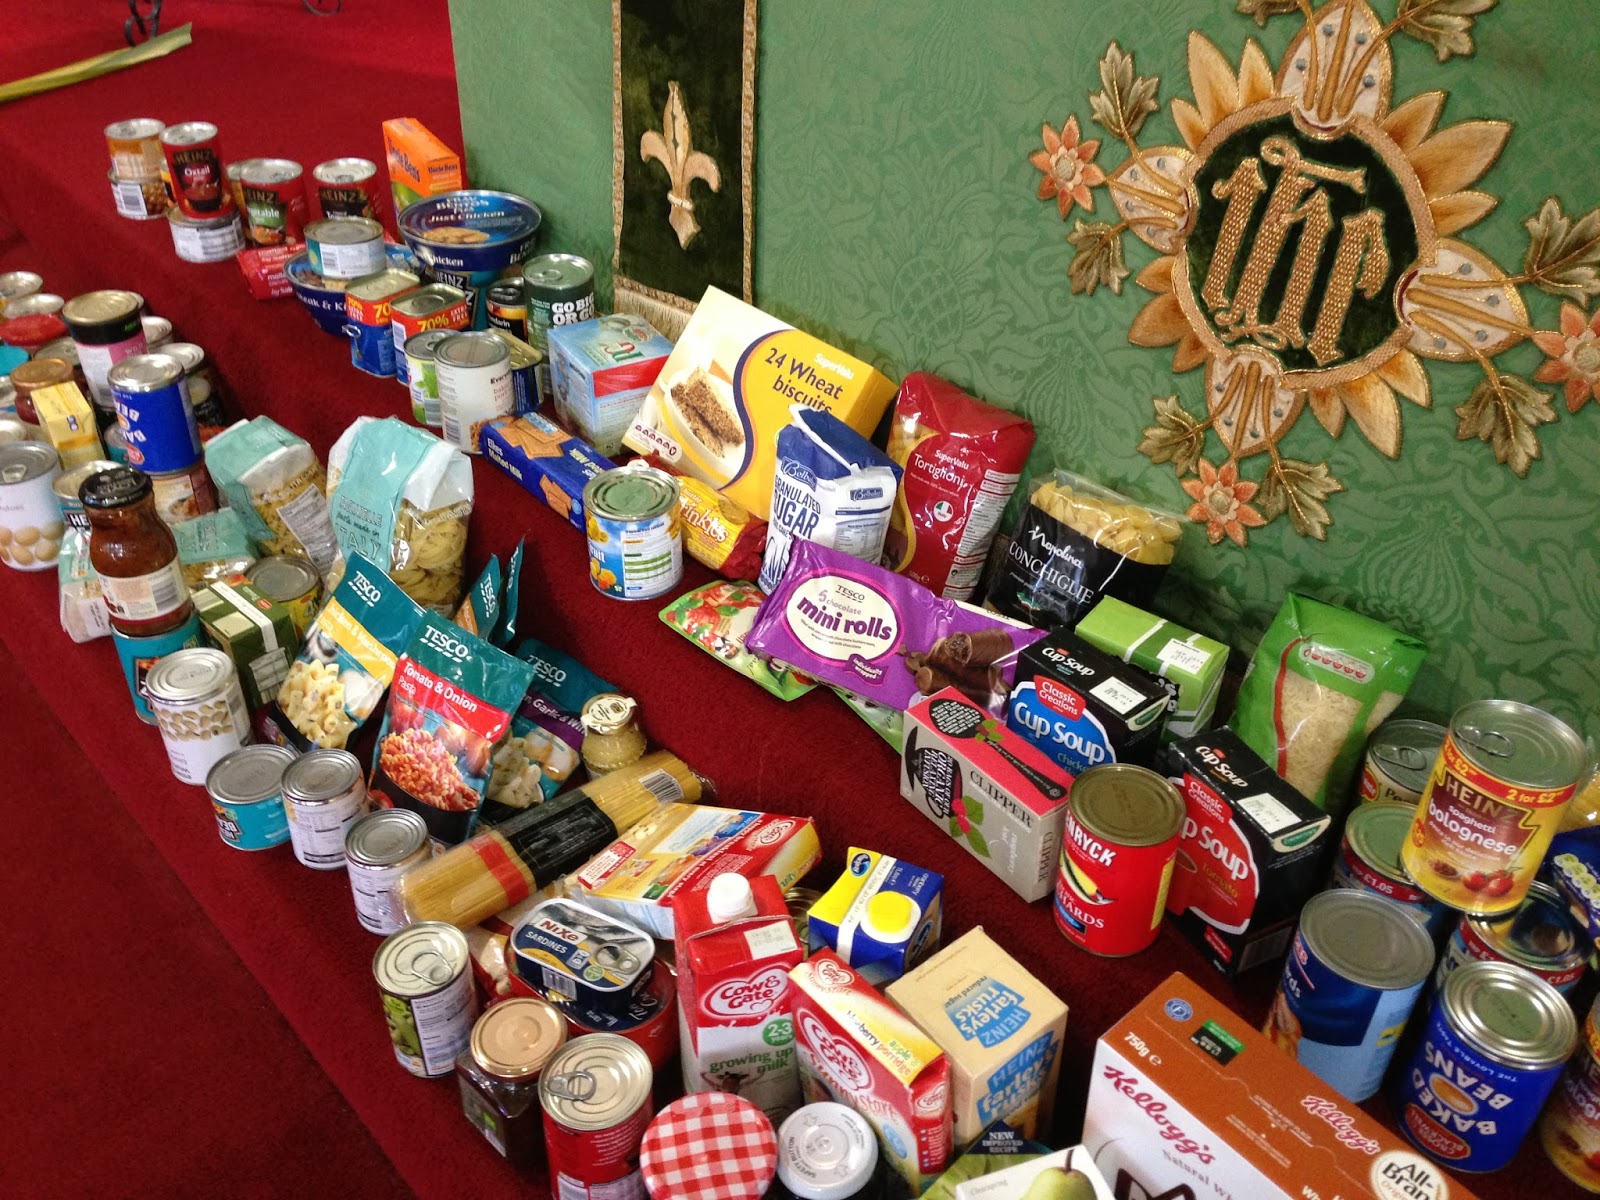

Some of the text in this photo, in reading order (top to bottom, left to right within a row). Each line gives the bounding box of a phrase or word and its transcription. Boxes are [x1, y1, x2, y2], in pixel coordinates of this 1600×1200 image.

[174, 149, 213, 163] HEINZ
[183, 166, 211, 176] Oxtail
[319, 187, 357, 201] HEINZ
[457, 210, 505, 221] Chicken
[551, 301, 574, 314] GO
[553, 312, 577, 326] OR
[417, 314, 449, 333] 70%
[765, 347, 844, 401] 24 Wheat
[814, 352, 855, 380] SuperValu
[772, 377, 833, 412] biscuits
[509, 463, 523, 480] Milk
[914, 453, 966, 490] Tortiglioni
[935, 449, 970, 470] SuperValu
[775, 475, 821, 515] GRANULATED
[774, 490, 819, 539] SUGAR
[354, 571, 382, 602] TESCO
[1009, 541, 1094, 604] CONCHIGLIE
[484, 573, 496, 614] TESCO
[826, 598, 862, 616] chocolate
[837, 585, 865, 602] TESCO
[797, 597, 892, 641] mini rolls
[426, 625, 468, 658] TESCO
[527, 655, 567, 682] TESCO
[1041, 647, 1095, 677] Cup Soup
[403, 662, 477, 712] Tomato & Onion
[1039, 690, 1078, 715] Creations
[1041, 681, 1076, 706] Classic
[532, 699, 559, 719] Garlic
[567, 718, 586, 735] Win
[1014, 701, 1051, 738] Cup
[1052, 723, 1105, 765] Soup
[1057, 752, 1089, 773] Chicke
[1195, 745, 1249, 788] Cup Soup
[935, 751, 947, 808] ORGANIC
[970, 770, 1034, 828] CLIPPER
[1188, 789, 1226, 824] Creations
[1189, 781, 1224, 813] Classic
[1445, 774, 1519, 824] HEINZ
[1505, 788, 1517, 801] 2
[1519, 793, 1536, 803] for
[1429, 798, 1517, 856] bolognese
[1448, 805, 1497, 834] spaghetti
[1198, 826, 1249, 881] Soup
[1363, 873, 1394, 894] £1.05
[525, 930, 567, 954] SARDINES
[720, 980, 766, 1001] Cow
[729, 989, 773, 1004] Gate
[955, 986, 1001, 1022] rusks
[960, 990, 1019, 1036] farley's
[982, 1009, 1028, 1046] HEINZ
[767, 1023, 793, 1037] 2-3
[1123, 1031, 1149, 1057] 750g
[710, 1047, 794, 1073] growing up
[877, 1043, 911, 1076] porridge
[889, 1040, 911, 1061] apple
[992, 1034, 1051, 1087] HEINZ
[1454, 1047, 1518, 1083] THE LOVABLE
[757, 1060, 788, 1074] milk
[1425, 1041, 1513, 1110] BEANS
[857, 1094, 901, 1121] Start
[1104, 1064, 1218, 1165] Kellogg's
[1412, 1067, 1498, 1136] BAKED
[989, 1131, 1014, 1140] NEW
[1301, 1095, 1381, 1155] Kellogg's
[982, 1139, 1023, 1147] IMPROVED
[1162, 1149, 1209, 1184] Natural
[1382, 1161, 1431, 1200] Bran
[1398, 1163, 1434, 1189] All-
